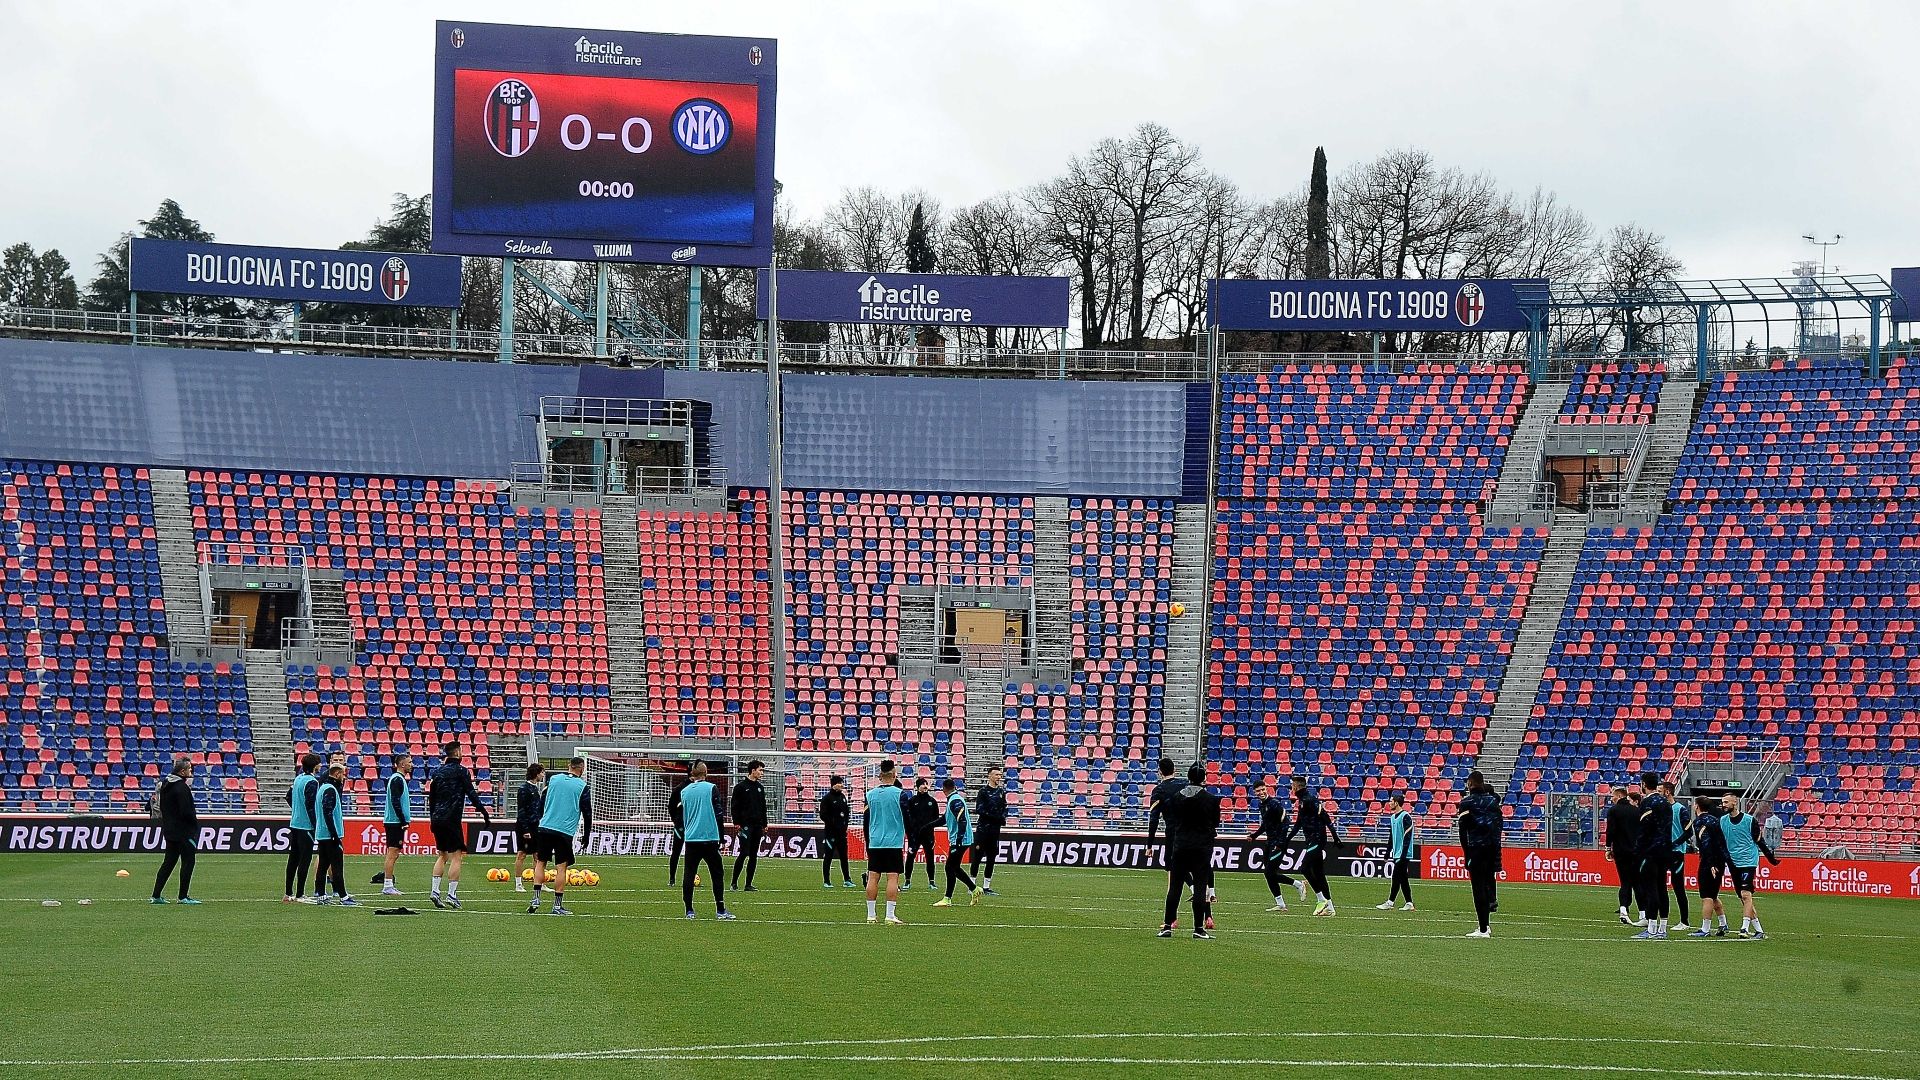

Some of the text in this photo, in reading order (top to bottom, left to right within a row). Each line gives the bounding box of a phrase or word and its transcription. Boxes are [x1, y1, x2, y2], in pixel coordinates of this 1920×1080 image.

[574, 36, 624, 54] facile
[575, 52, 642, 66] ristrutturare
[500, 82, 526, 99] BFC
[503, 97, 522, 105] 1909
[579, 180, 634, 198] 00:00
[504, 240, 554, 255] Selenella
[673, 246, 697, 260] scala
[187, 253, 373, 291] BOLOGNA FC 1909
[857, 276, 940, 305] facile
[860, 303, 972, 322] ristrutturare
[1269, 290, 1448, 319] BOLOGNA FC 1909
[1350, 860, 1396, 878] 00:0
[1523, 851, 1579, 871] facile
[1430, 866, 1507, 880] ristrutre
[1524, 868, 1602, 884] ristrutturare
[1811, 861, 1868, 881] facile
[1812, 879, 1892, 894] ristrutturare
